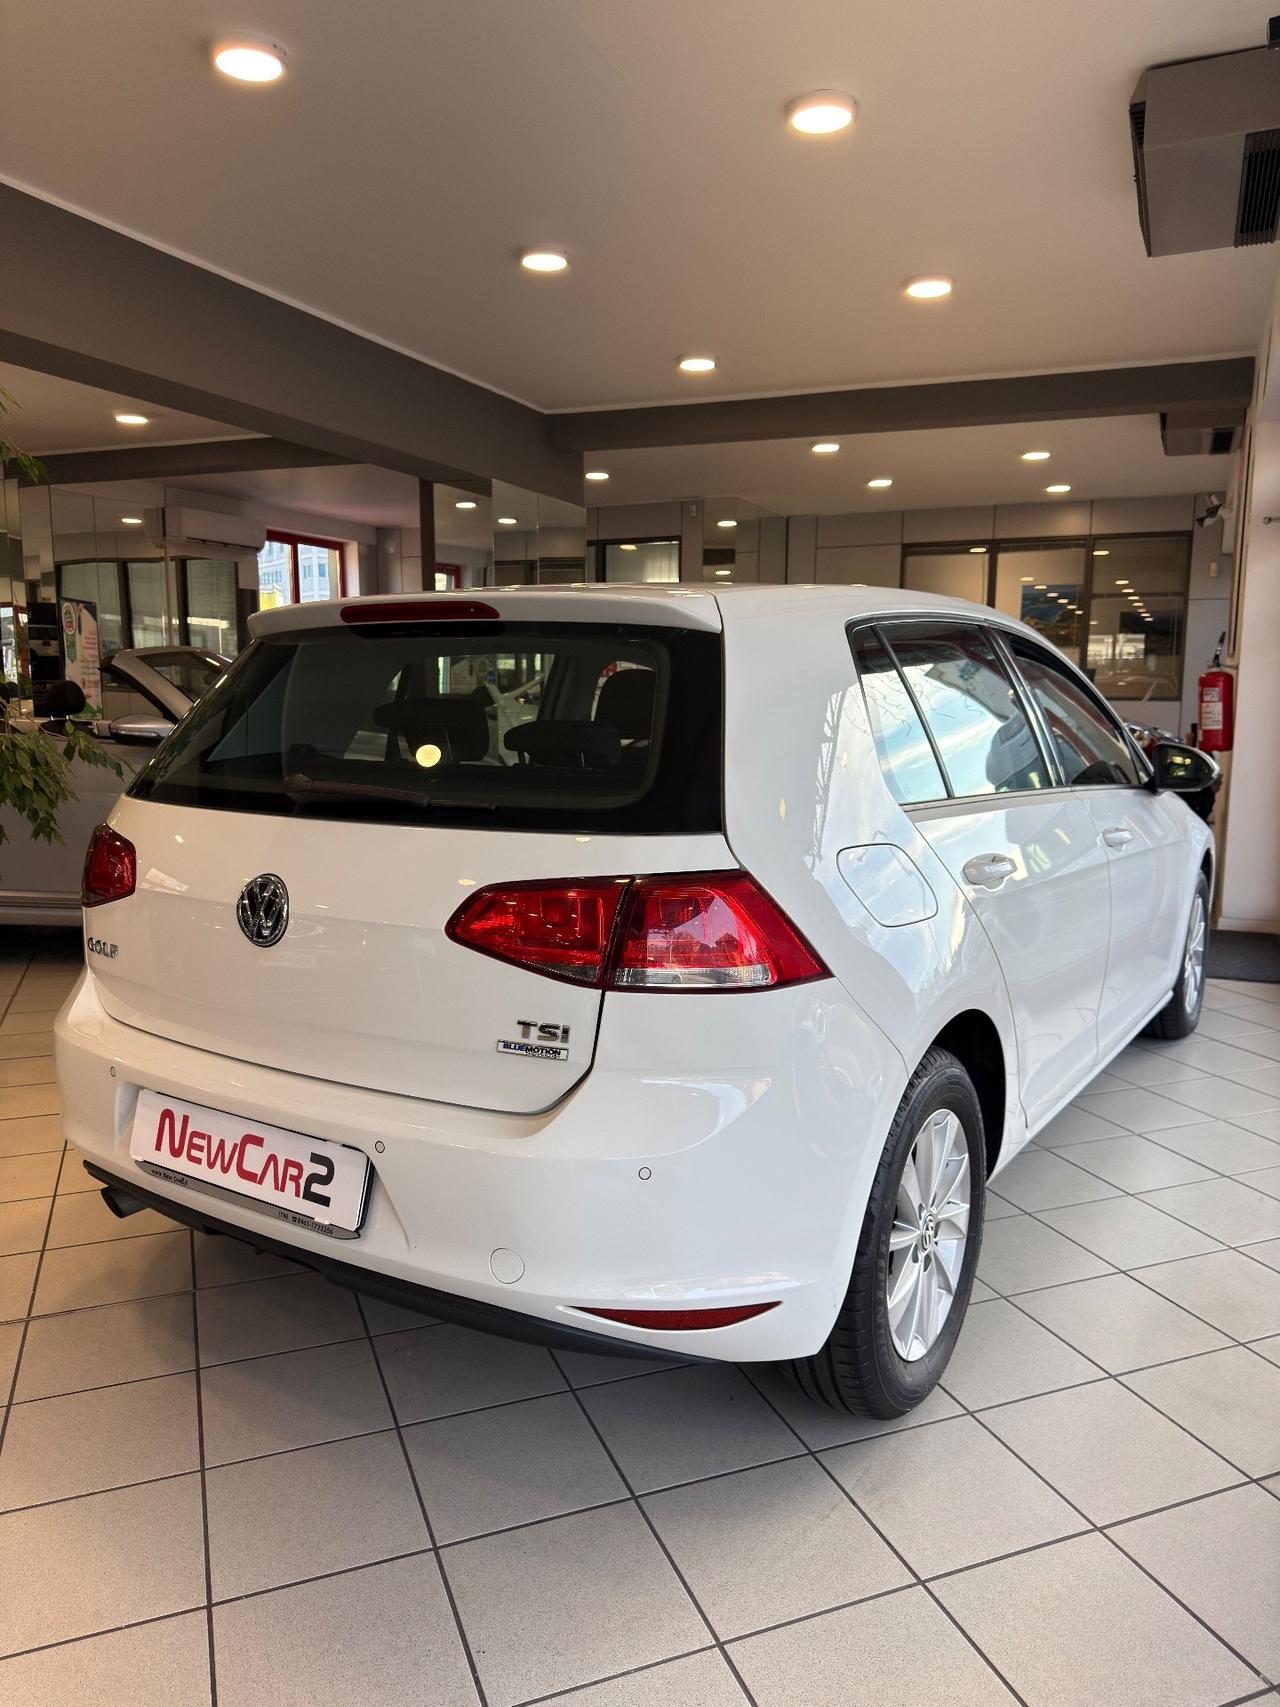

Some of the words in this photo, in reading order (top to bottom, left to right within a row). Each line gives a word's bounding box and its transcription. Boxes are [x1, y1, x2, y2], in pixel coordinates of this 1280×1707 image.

[87, 936, 119, 960] GOLF
[517, 1019, 570, 1043] TSI
[503, 1042, 561, 1055] BLUEMOTION
